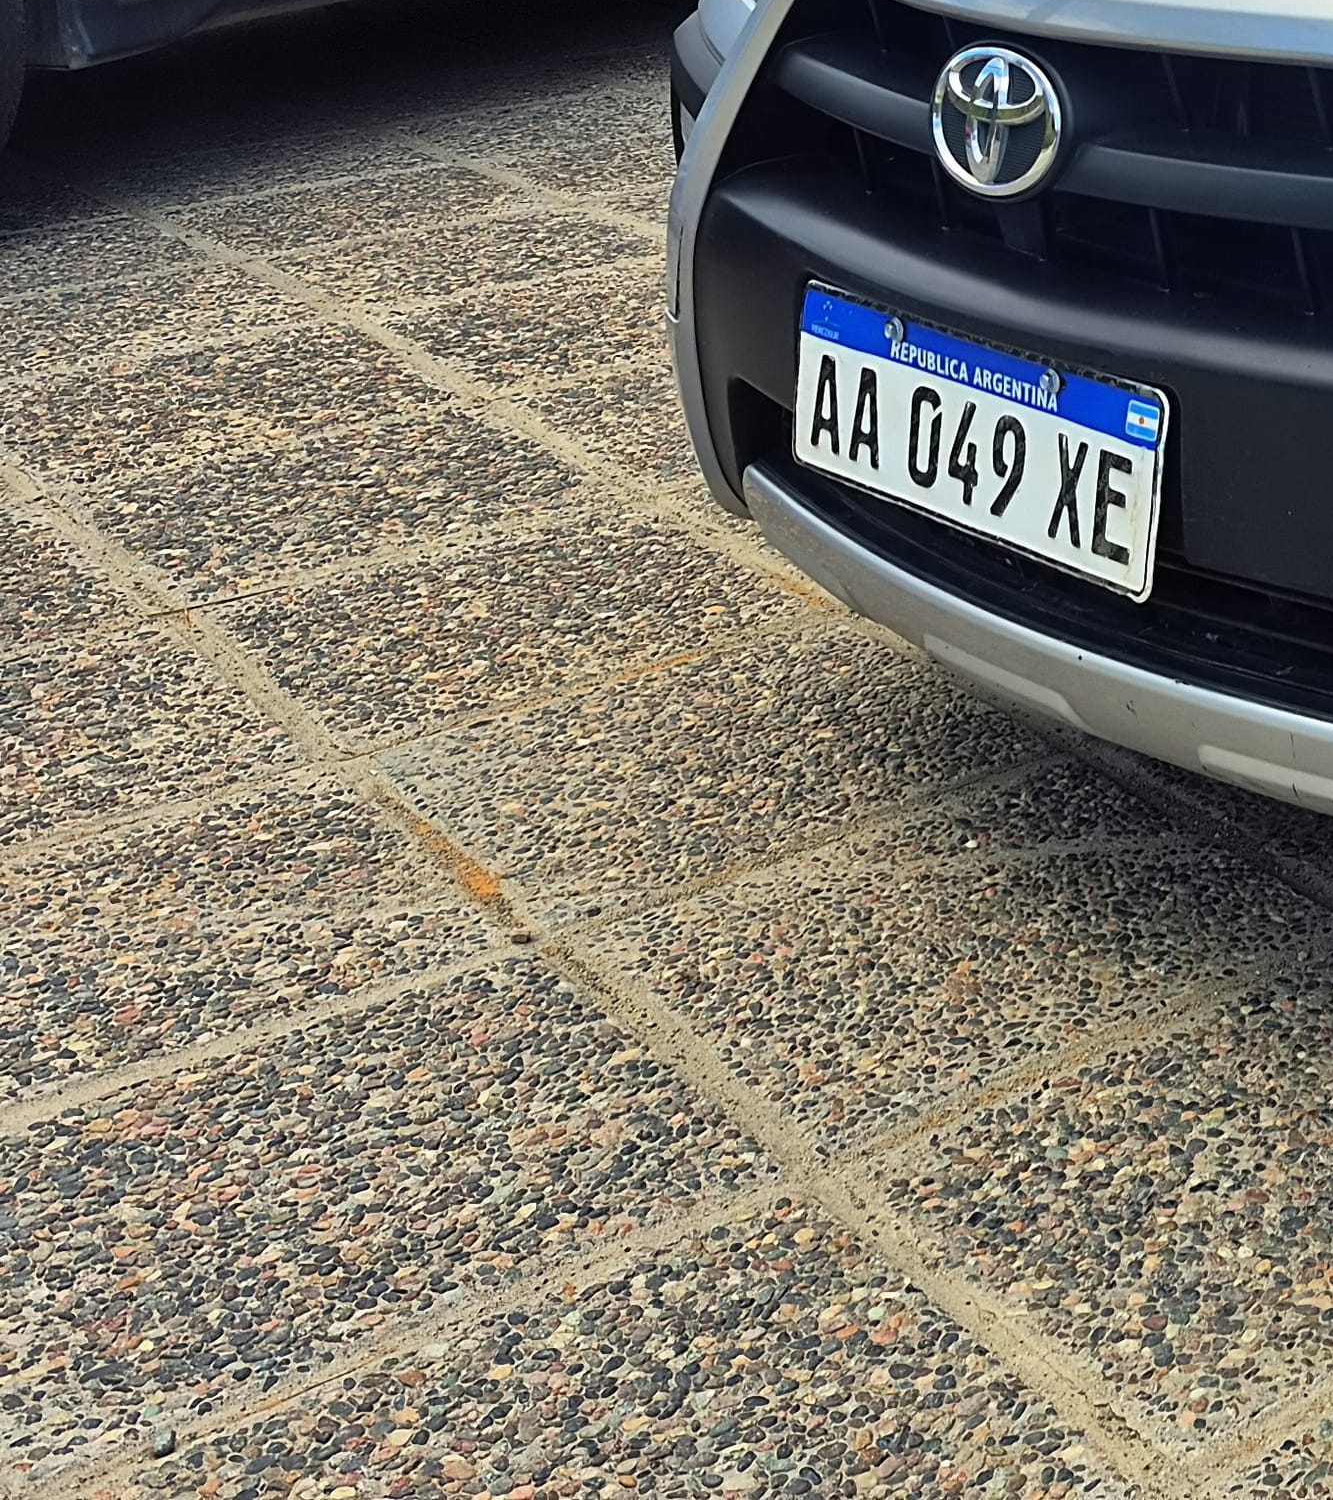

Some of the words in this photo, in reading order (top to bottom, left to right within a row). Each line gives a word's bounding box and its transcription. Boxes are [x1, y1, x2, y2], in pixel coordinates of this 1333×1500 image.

[889, 340, 969, 383] REPUBLICA
[973, 366, 1058, 412] ARGENTINA
[810, 354, 880, 471] AA
[908, 385, 1027, 518] 049
[1047, 433, 1134, 566] XE
